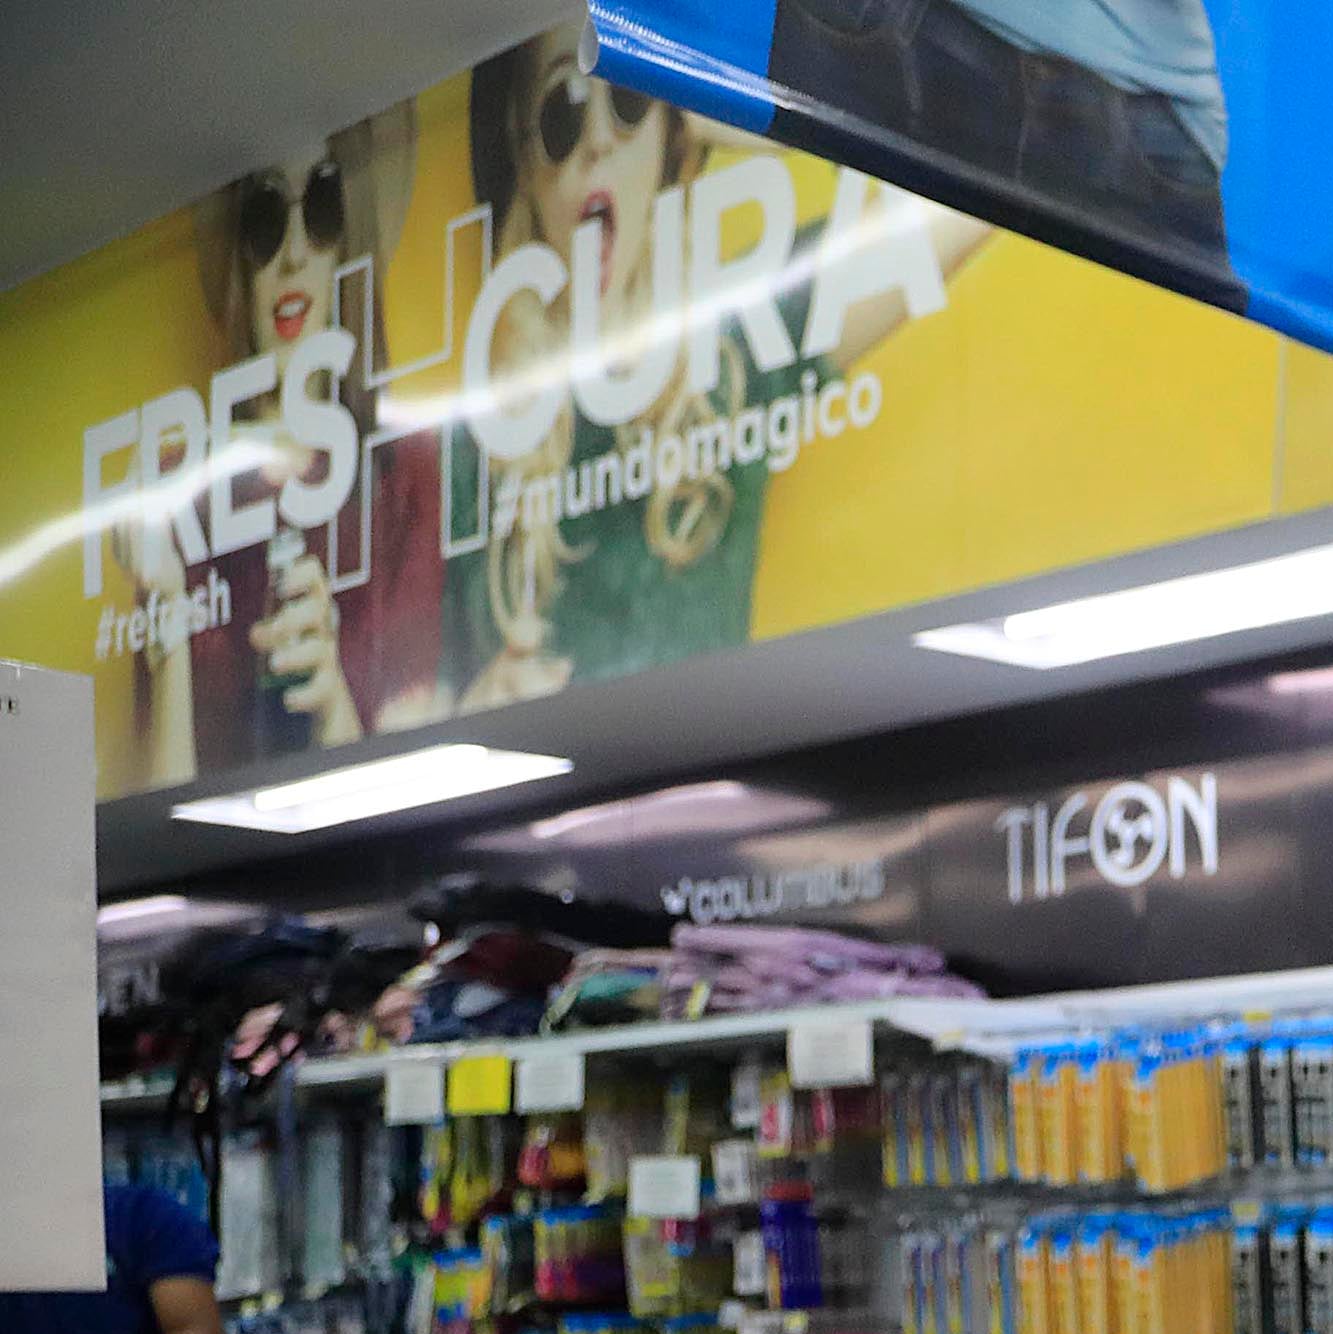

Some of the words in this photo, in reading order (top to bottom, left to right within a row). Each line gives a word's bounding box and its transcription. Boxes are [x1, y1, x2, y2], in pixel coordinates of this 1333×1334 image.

[494, 368, 883, 536] #mundomagico
[94, 567, 232, 660] #refrsh
[997, 772, 1219, 905] TIFON
